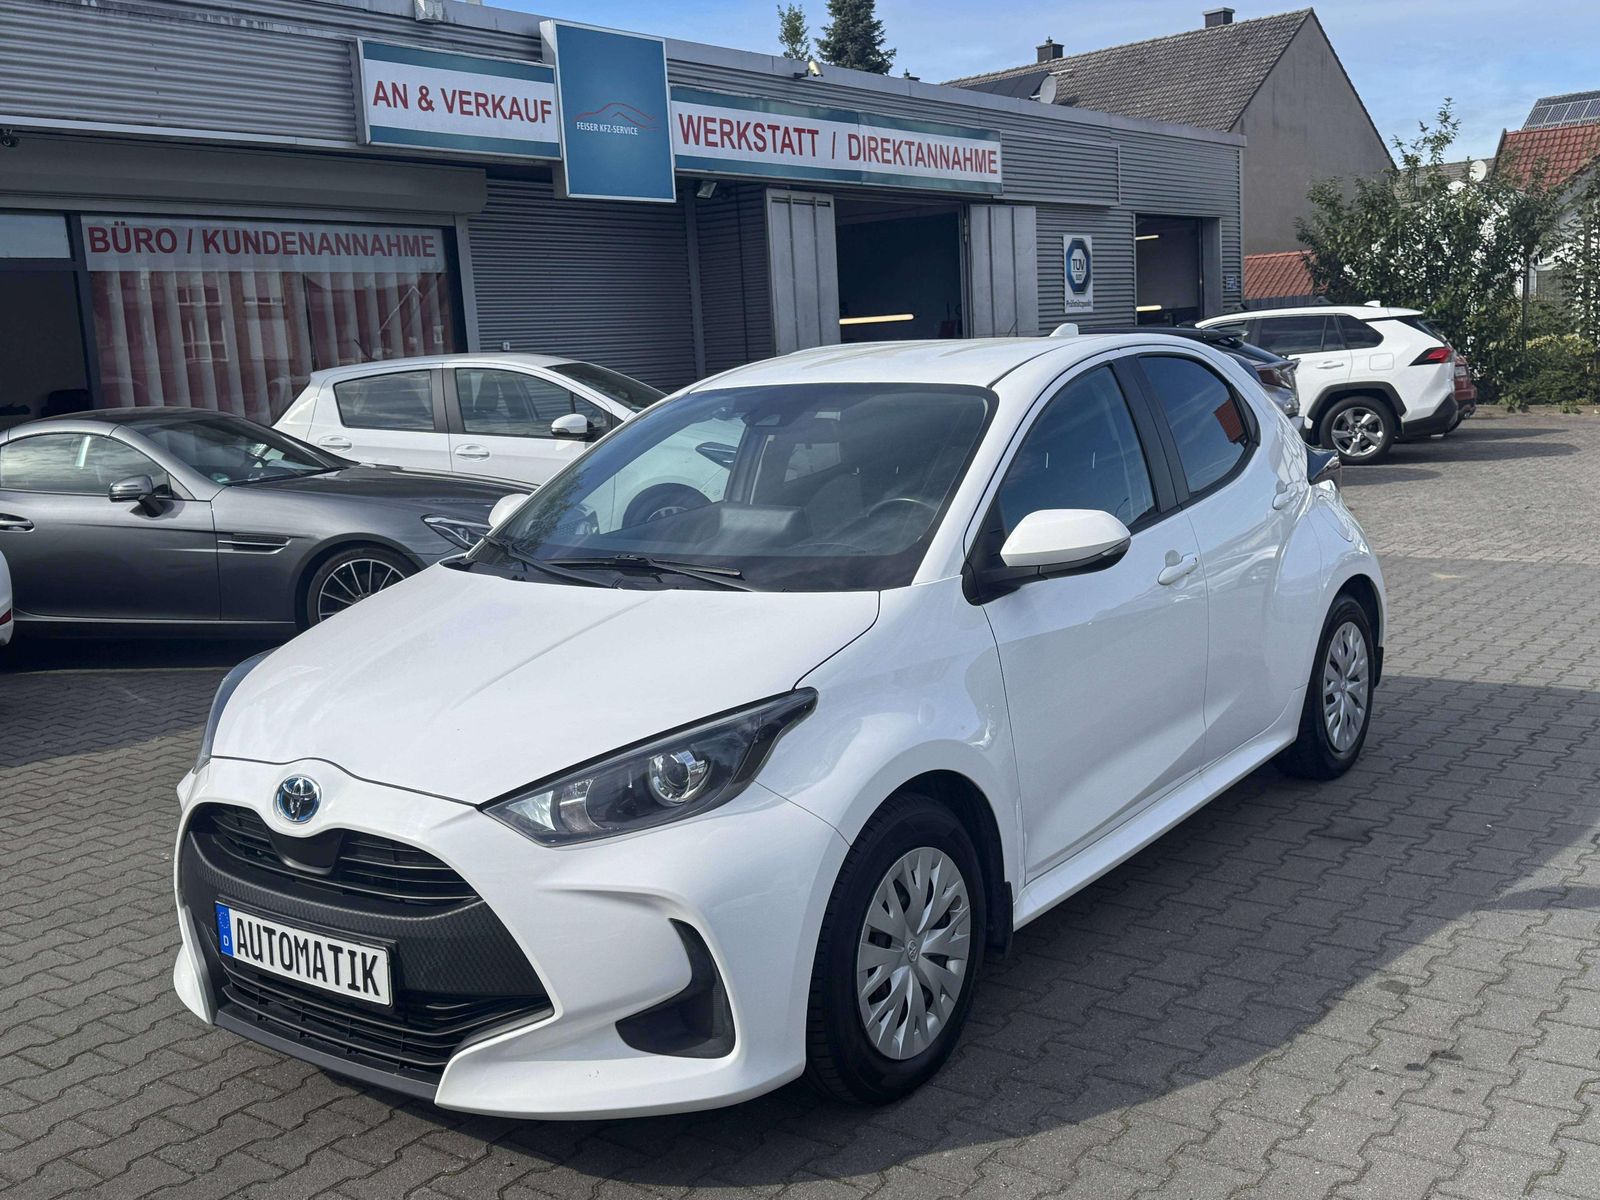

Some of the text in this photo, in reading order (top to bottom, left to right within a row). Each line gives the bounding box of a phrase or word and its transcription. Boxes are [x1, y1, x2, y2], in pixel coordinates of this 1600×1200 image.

[372, 80, 552, 123] AN & VERKAUF
[576, 121, 638, 136] FEISER KFZ-SERVICE
[678, 113, 998, 175] WERKSTATT / DIREKTANNAHME
[87, 221, 437, 258] BÜRO / KUNDENANNAHME
[223, 917, 381, 997] D AUTOMATIK
